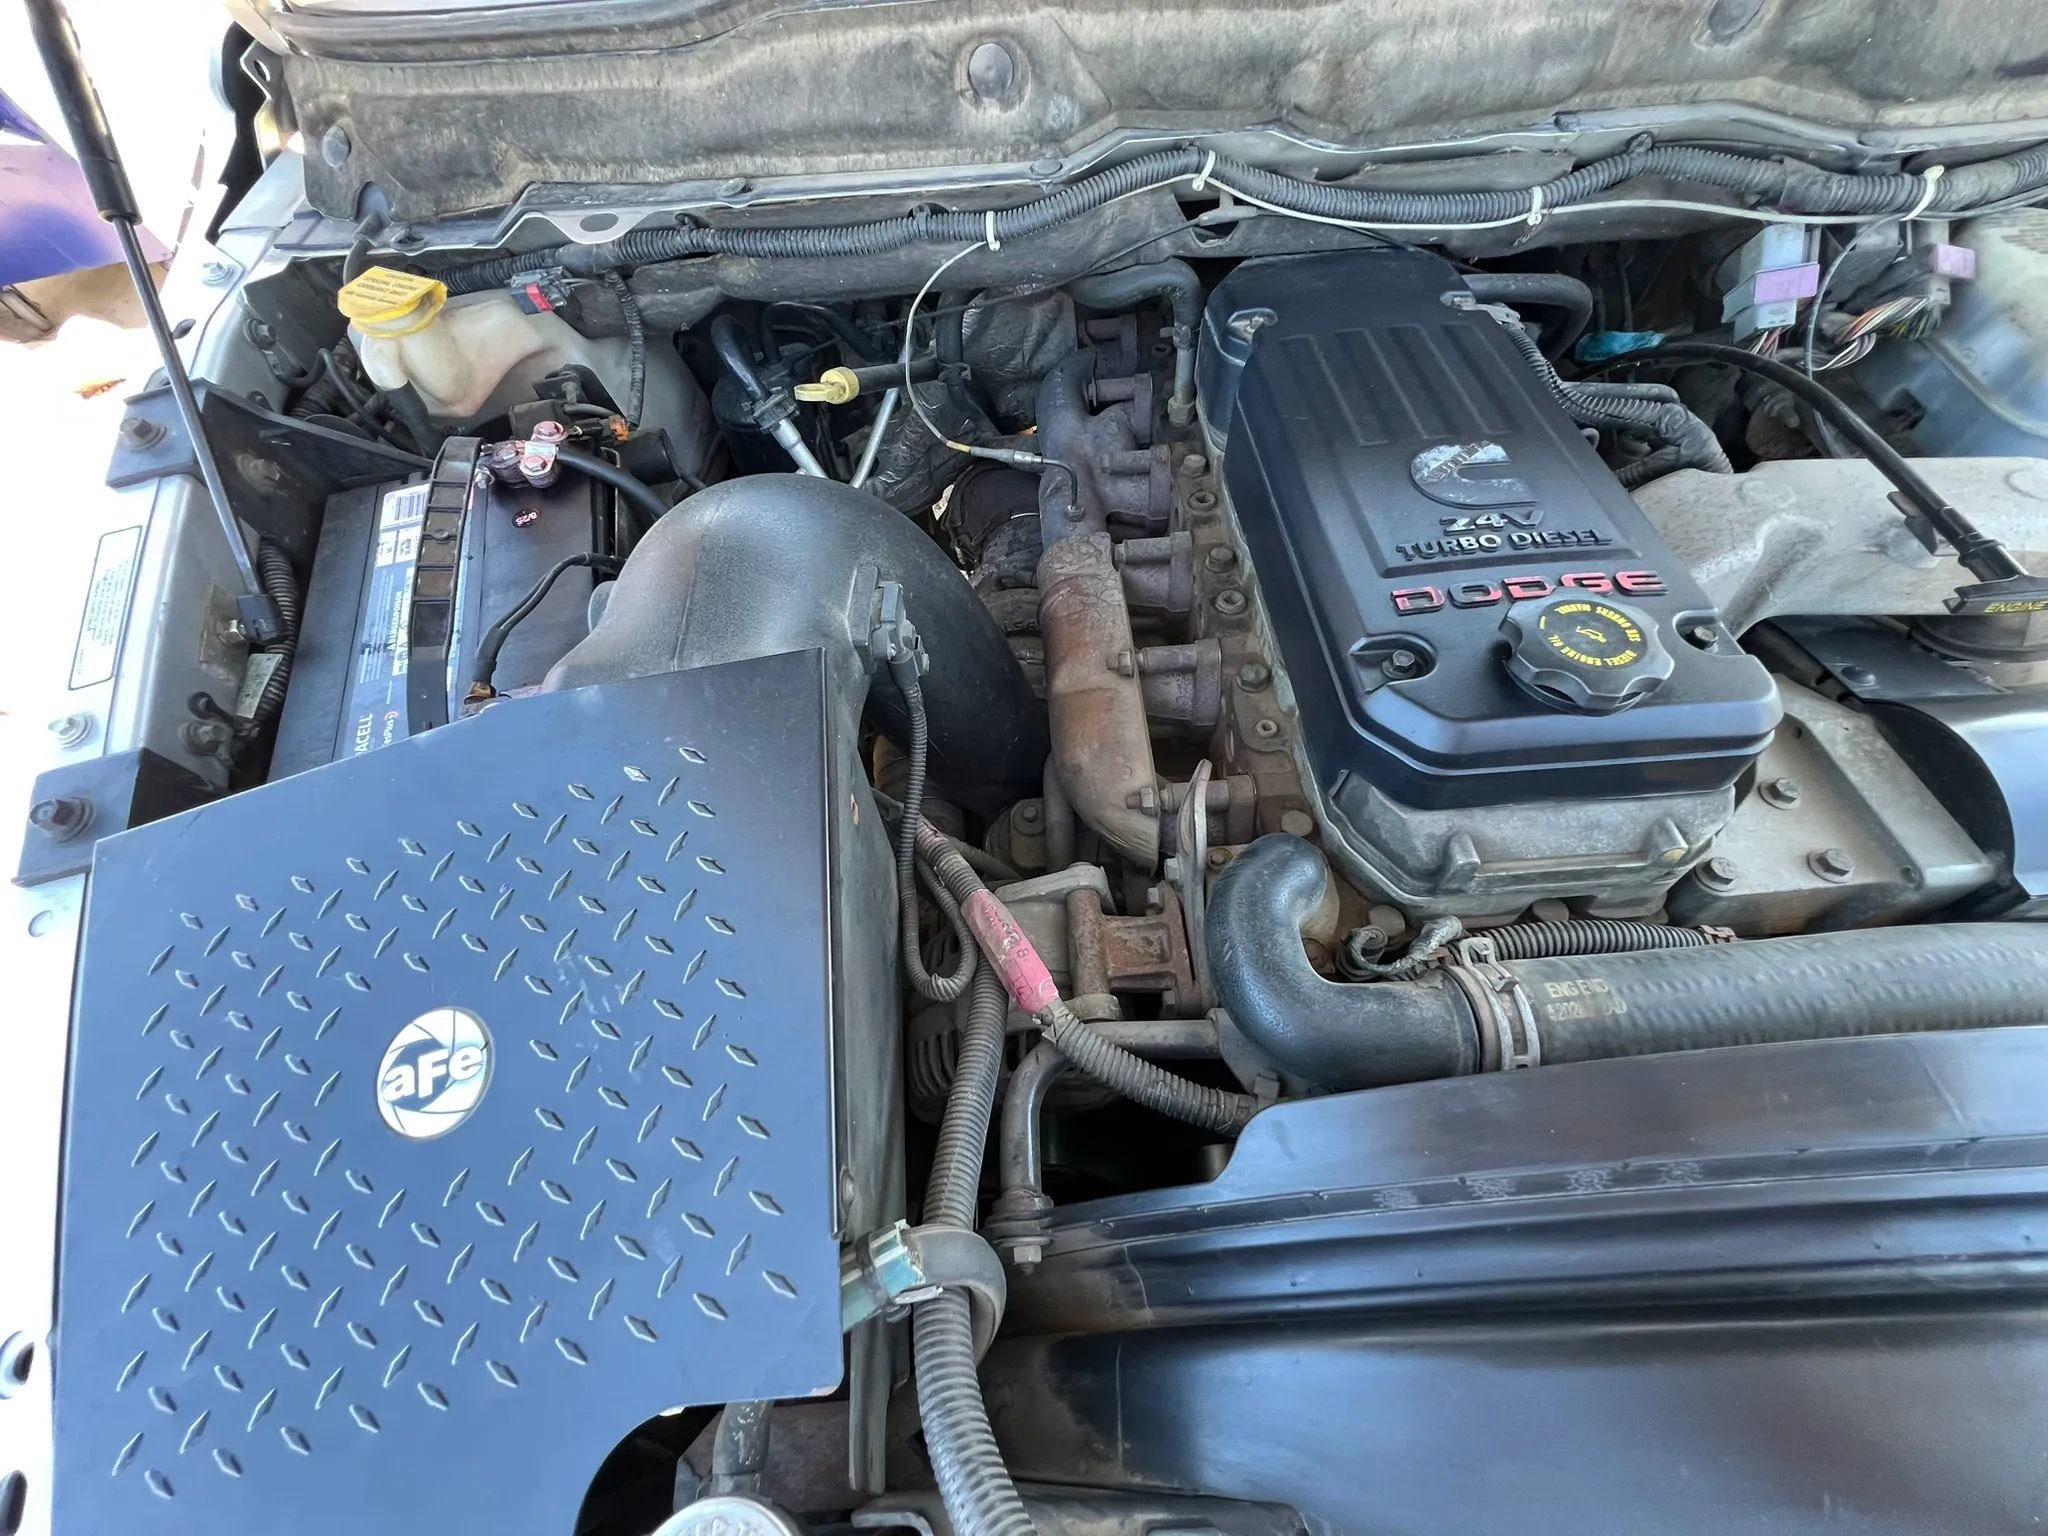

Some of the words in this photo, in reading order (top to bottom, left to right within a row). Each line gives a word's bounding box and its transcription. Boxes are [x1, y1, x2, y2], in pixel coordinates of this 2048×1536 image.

[1439, 511, 1543, 536] 24V
[1396, 533, 1502, 561] TURBO
[1509, 528, 1613, 550] DIESEL
[1391, 570, 1670, 616] DODGE
[1983, 602, 2046, 614] ENGINE
[1547, 634, 1564, 648] OIL
[1560, 646, 1602, 666] ENGINE
[354, 713, 374, 756] ACELL
[1543, 981, 1580, 998] ENG
[382, 1045, 484, 1103] aFe
